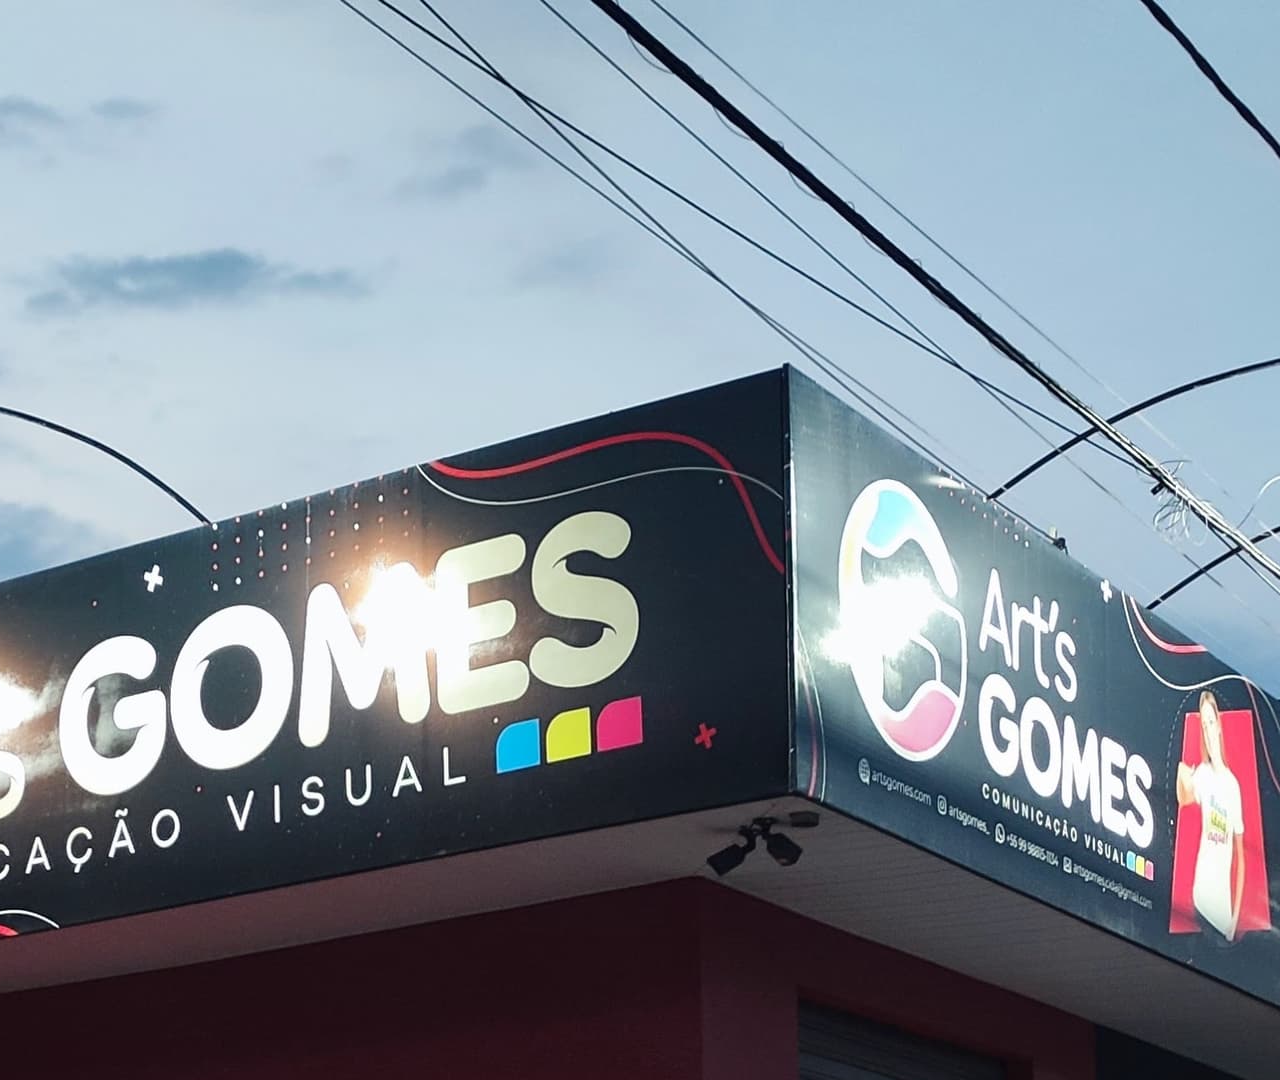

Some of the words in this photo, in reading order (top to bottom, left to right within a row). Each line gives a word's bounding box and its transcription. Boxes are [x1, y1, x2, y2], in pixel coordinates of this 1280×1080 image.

[59, 510, 640, 797] GOMES
[979, 567, 1079, 702] Art's
[226, 746, 467, 833] VISUAL
[978, 673, 1154, 848] GOMES
[982, 783, 1078, 843] COMUNICAÇÃO
[1084, 833, 1126, 867] VISUAL
